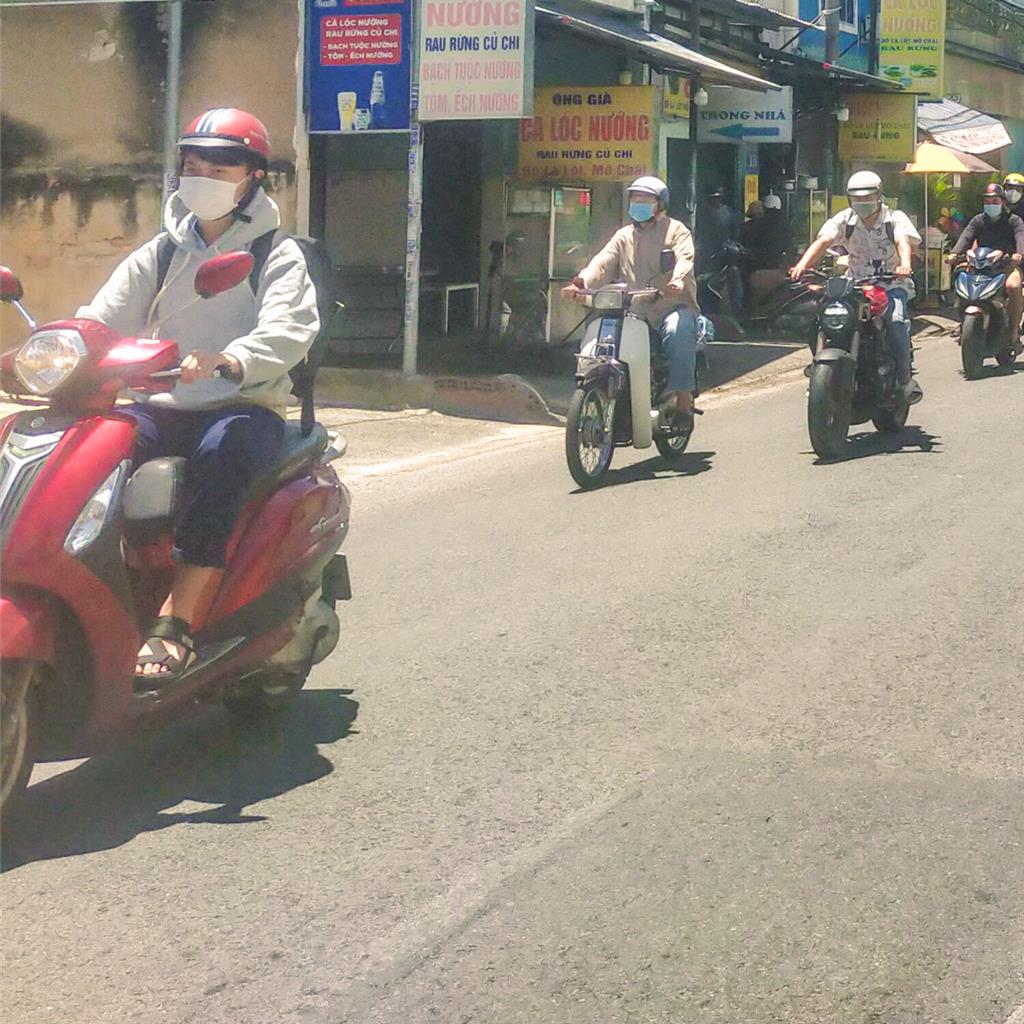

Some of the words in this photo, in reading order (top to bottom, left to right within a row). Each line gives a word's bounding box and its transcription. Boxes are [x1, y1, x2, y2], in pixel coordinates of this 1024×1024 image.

[425, 37, 446, 53] RAU
[449, 33, 480, 52] RỪNG
[483, 32, 498, 51] CỦ
[501, 36, 520, 50] CHI
[589, 110, 649, 142] NƯỚNG
[614, 150, 632, 158] CHI
